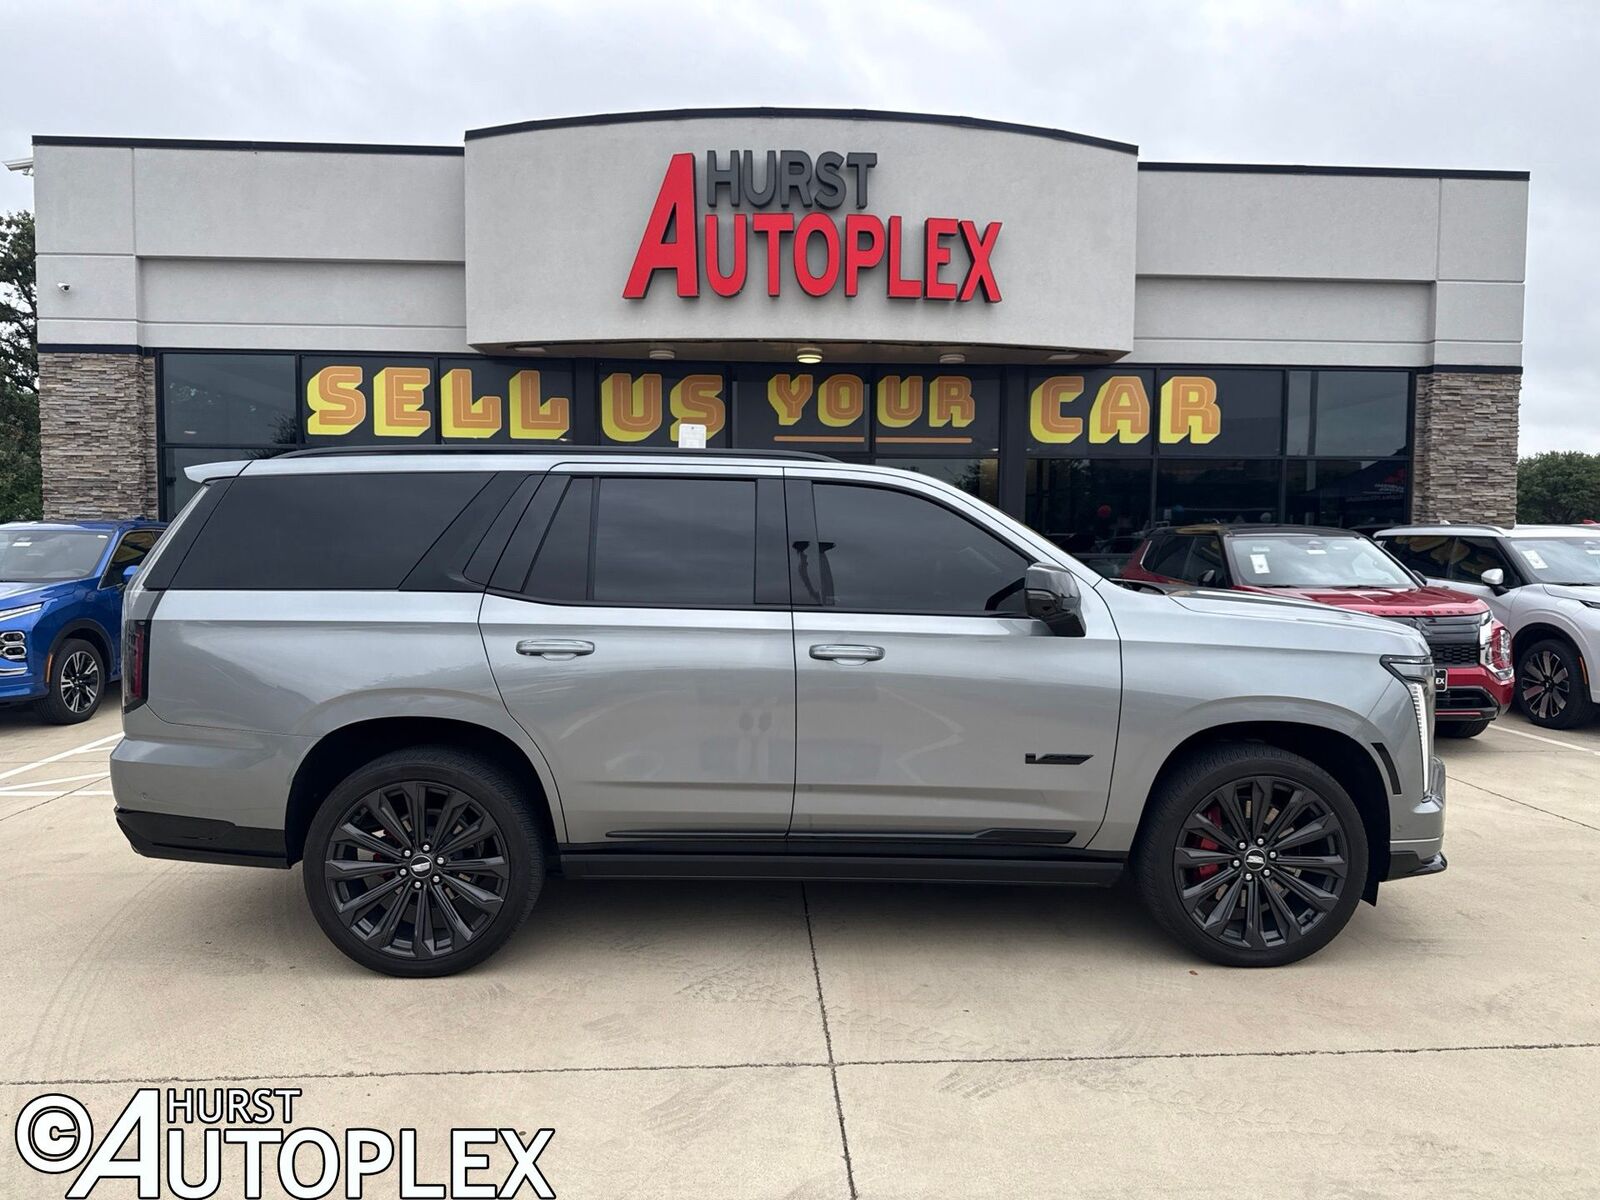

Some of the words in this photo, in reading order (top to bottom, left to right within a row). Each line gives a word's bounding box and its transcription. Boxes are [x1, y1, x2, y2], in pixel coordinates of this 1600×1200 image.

[707, 150, 878, 210] HURST
[622, 152, 1003, 303] AUTOPLEX
[307, 365, 570, 440] SELL
[601, 372, 726, 443] US
[767, 373, 976, 428] YOUR
[1030, 375, 1221, 444] CAR
